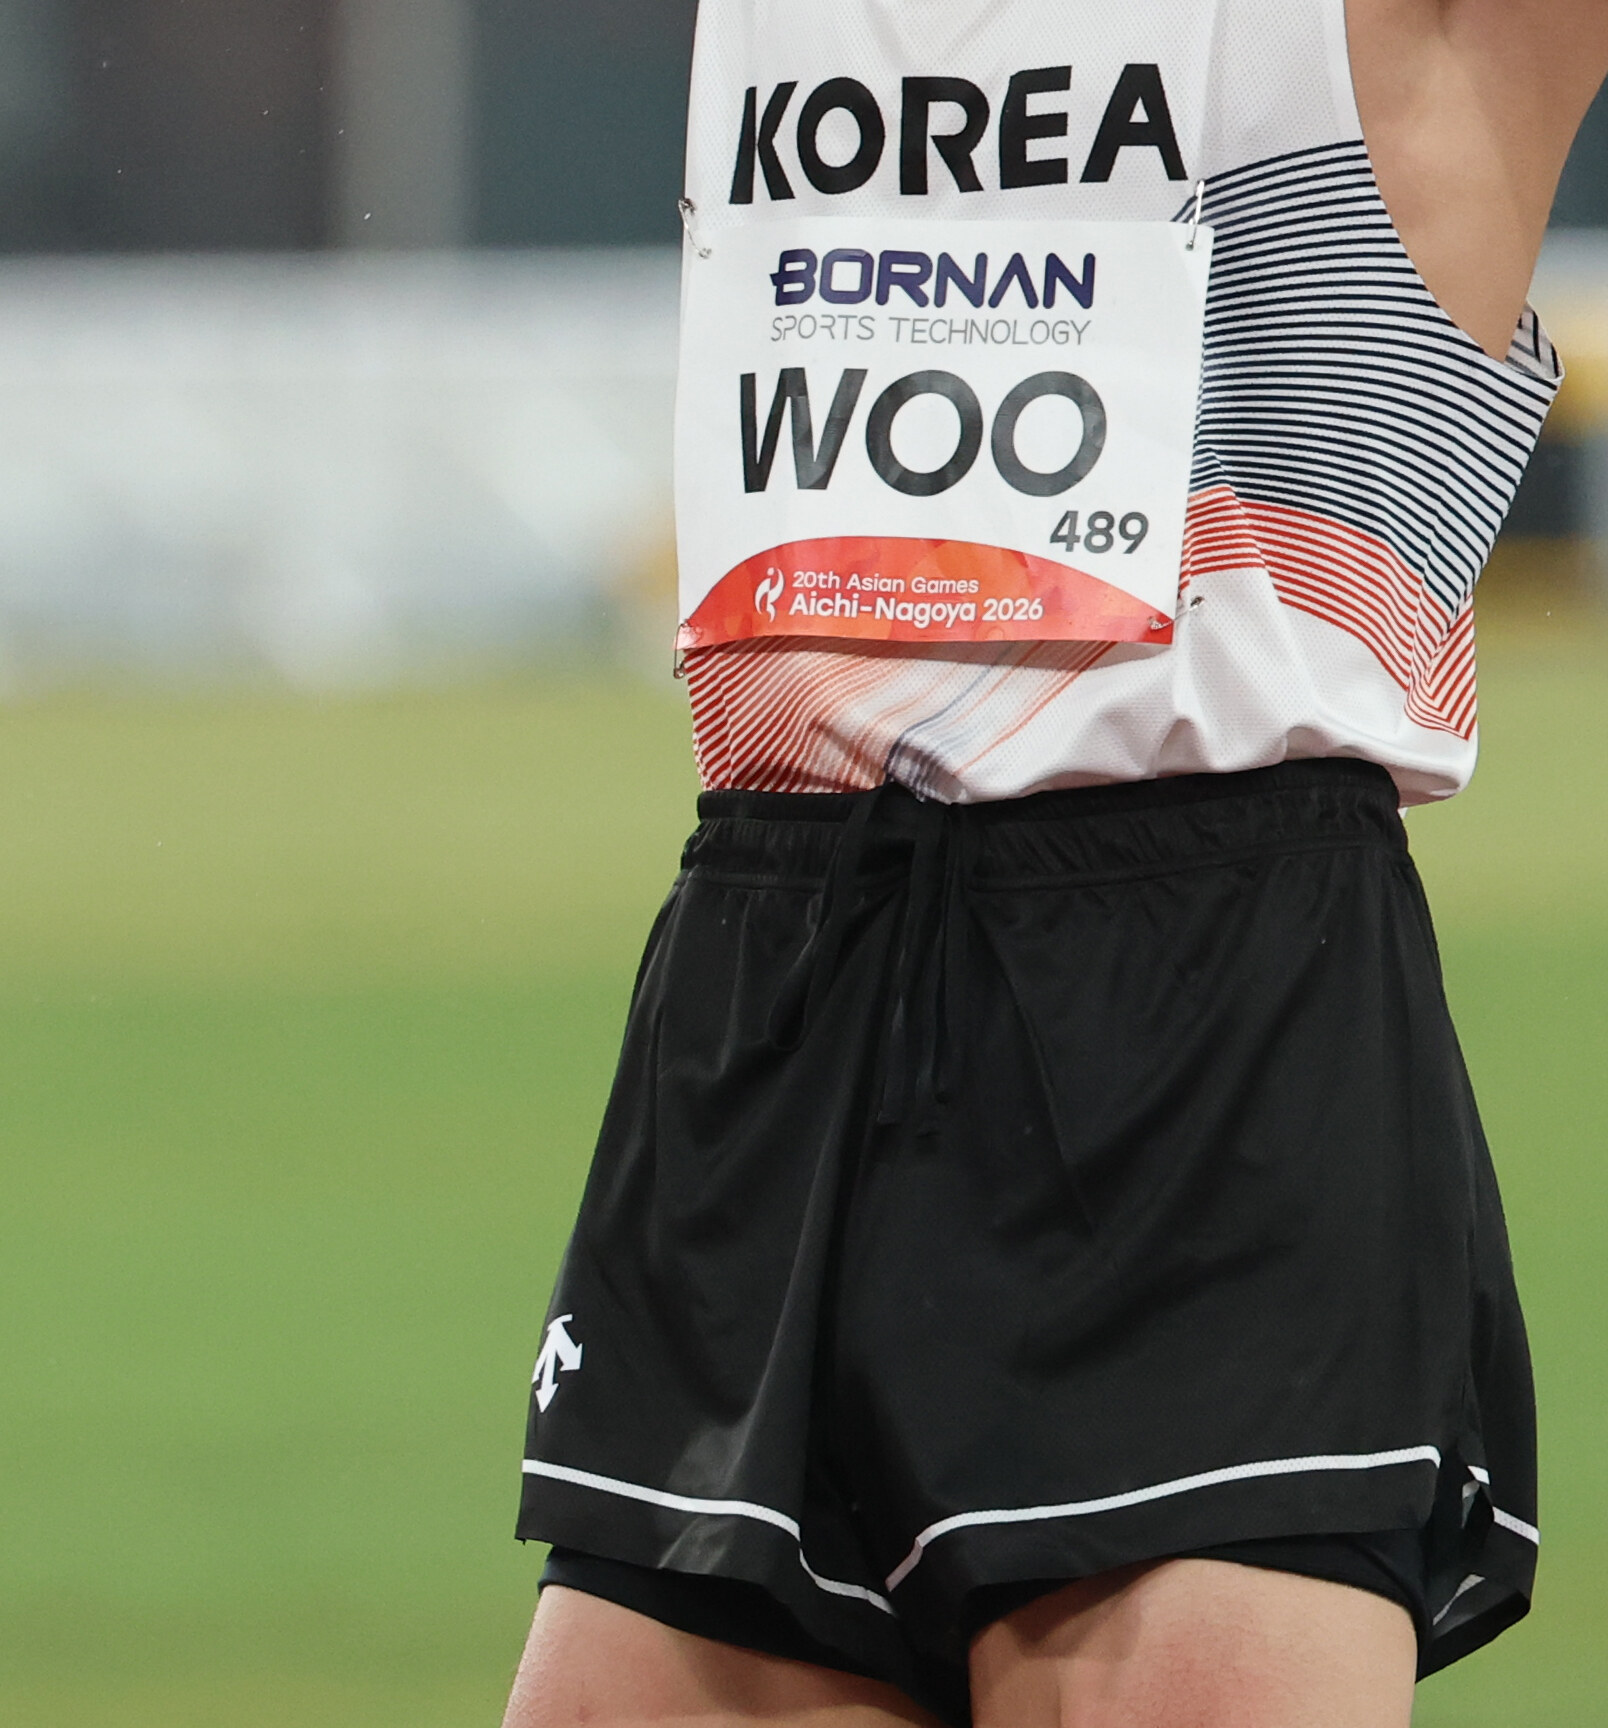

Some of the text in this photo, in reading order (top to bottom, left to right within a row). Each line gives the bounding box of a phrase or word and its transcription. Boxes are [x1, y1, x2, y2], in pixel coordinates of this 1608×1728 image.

[729, 63, 1189, 205] KOREA
[770, 248, 1095, 309] BORNAN
[770, 315, 1092, 346] SPORTS TECHNOLOGY
[739, 367, 1107, 497] WOO
[1050, 510, 1149, 554] 489
[792, 571, 979, 594] 20th Asian Games
[789, 592, 1043, 628] Aichi-Nagoya 2026
